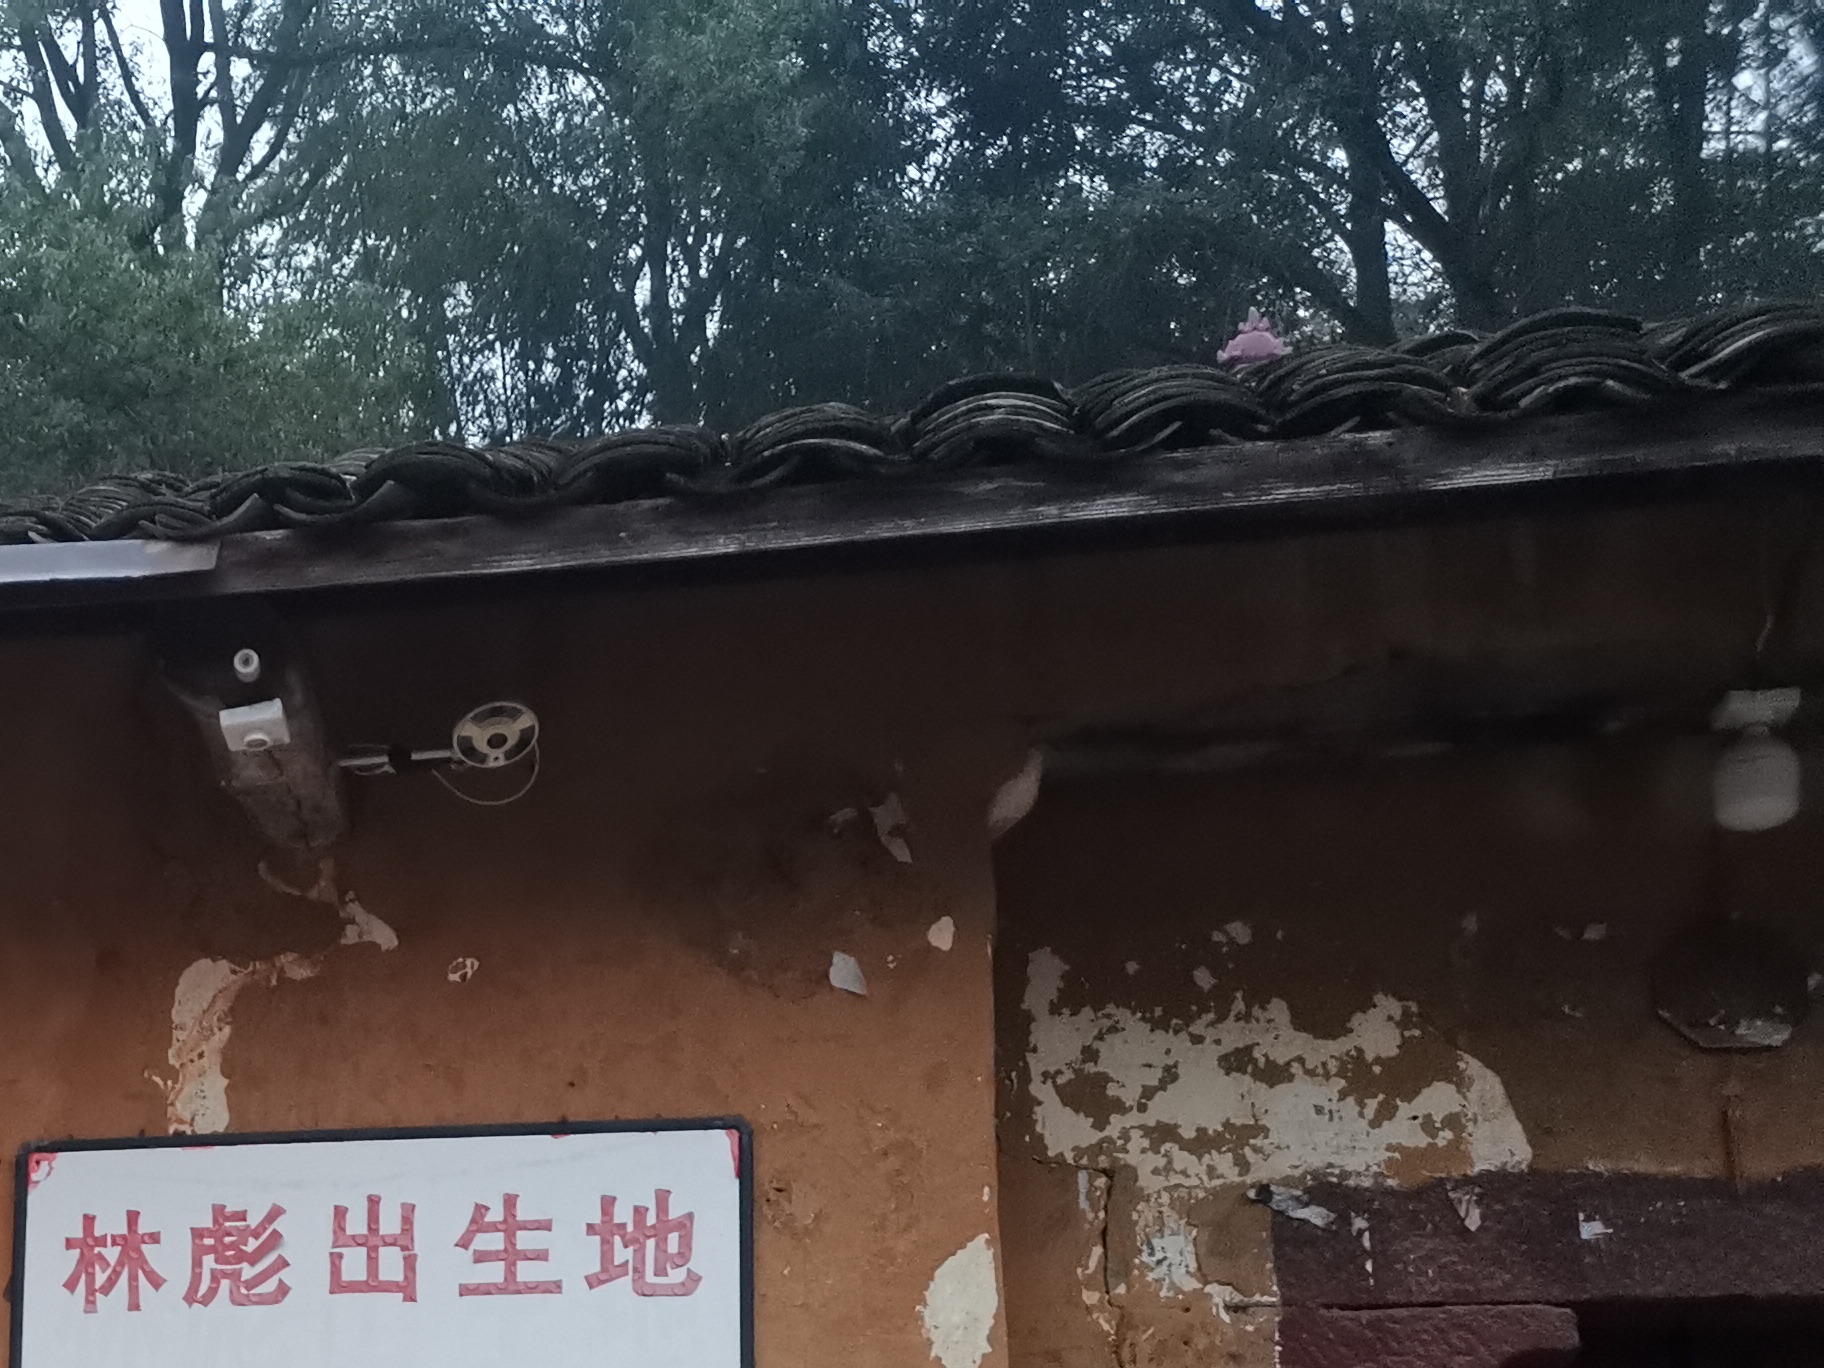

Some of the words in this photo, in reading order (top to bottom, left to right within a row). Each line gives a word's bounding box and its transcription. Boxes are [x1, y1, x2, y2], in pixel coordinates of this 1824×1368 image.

[62, 1188, 703, 1314] 林彪出生地
